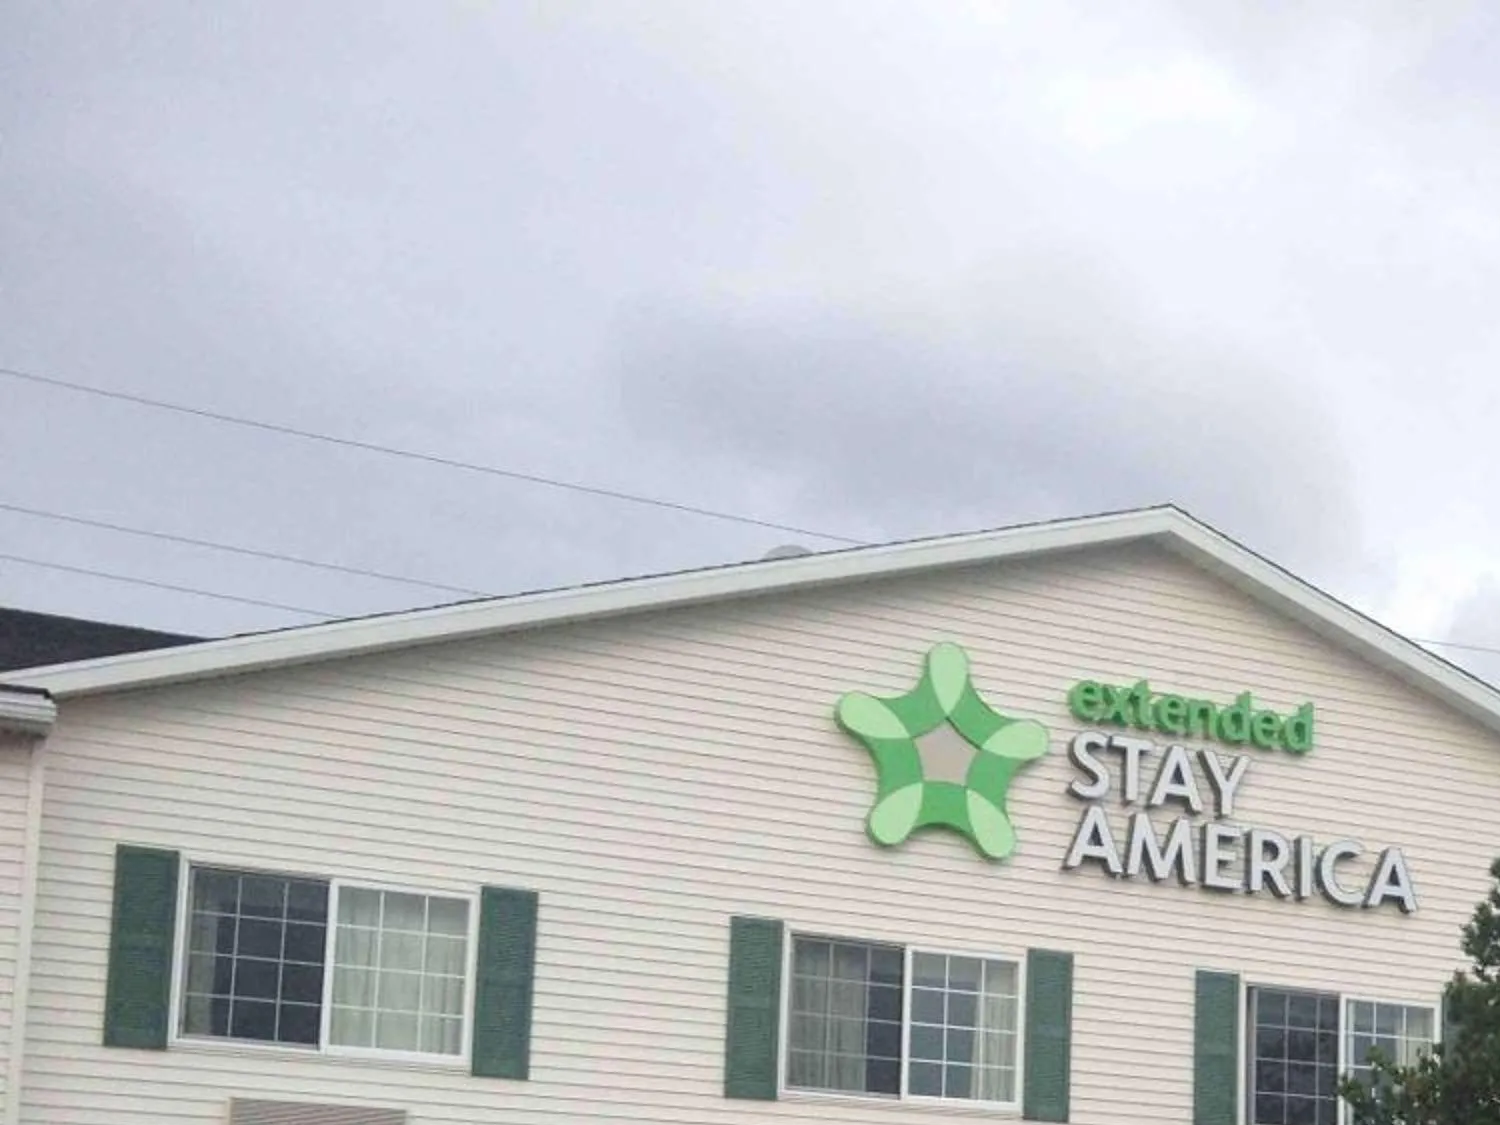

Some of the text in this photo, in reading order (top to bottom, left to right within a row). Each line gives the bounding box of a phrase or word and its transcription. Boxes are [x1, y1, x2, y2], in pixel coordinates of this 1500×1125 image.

[1069, 680, 1314, 752] extended
[1069, 731, 1249, 816] STAY
[1062, 805, 1418, 913] AMERICA
